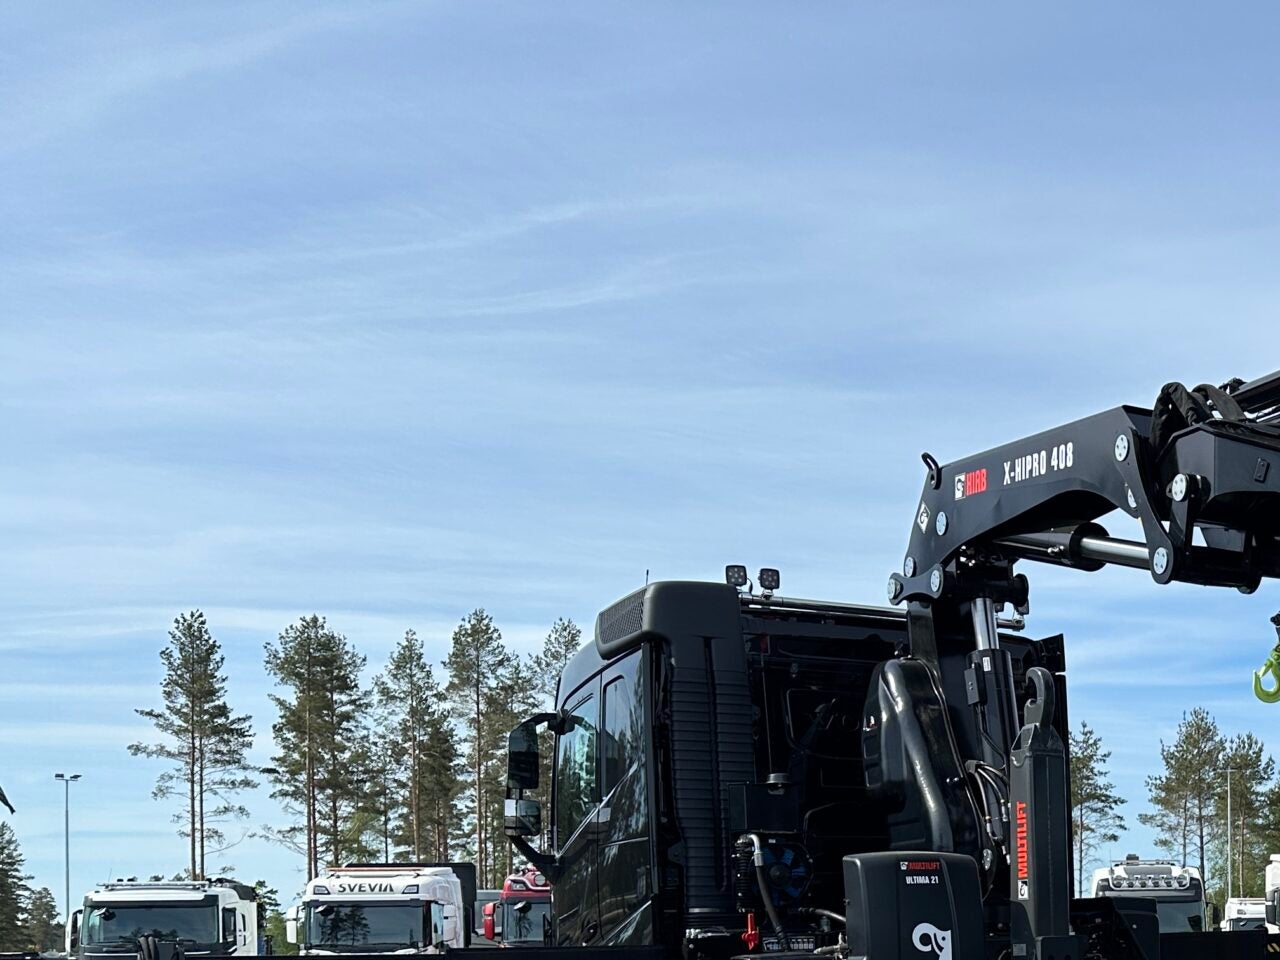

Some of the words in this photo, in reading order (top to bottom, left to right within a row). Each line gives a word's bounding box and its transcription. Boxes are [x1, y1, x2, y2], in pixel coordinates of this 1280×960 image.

[1003, 450, 1047, 486] X-HIPRO
[1051, 442, 1073, 471] 408
[966, 468, 987, 496] HIAB
[1016, 801, 1028, 878] MULTILIFT
[338, 883, 394, 892] SVEVIA
[905, 875, 930, 884] ULTIMA
[930, 875, 939, 884] 21
